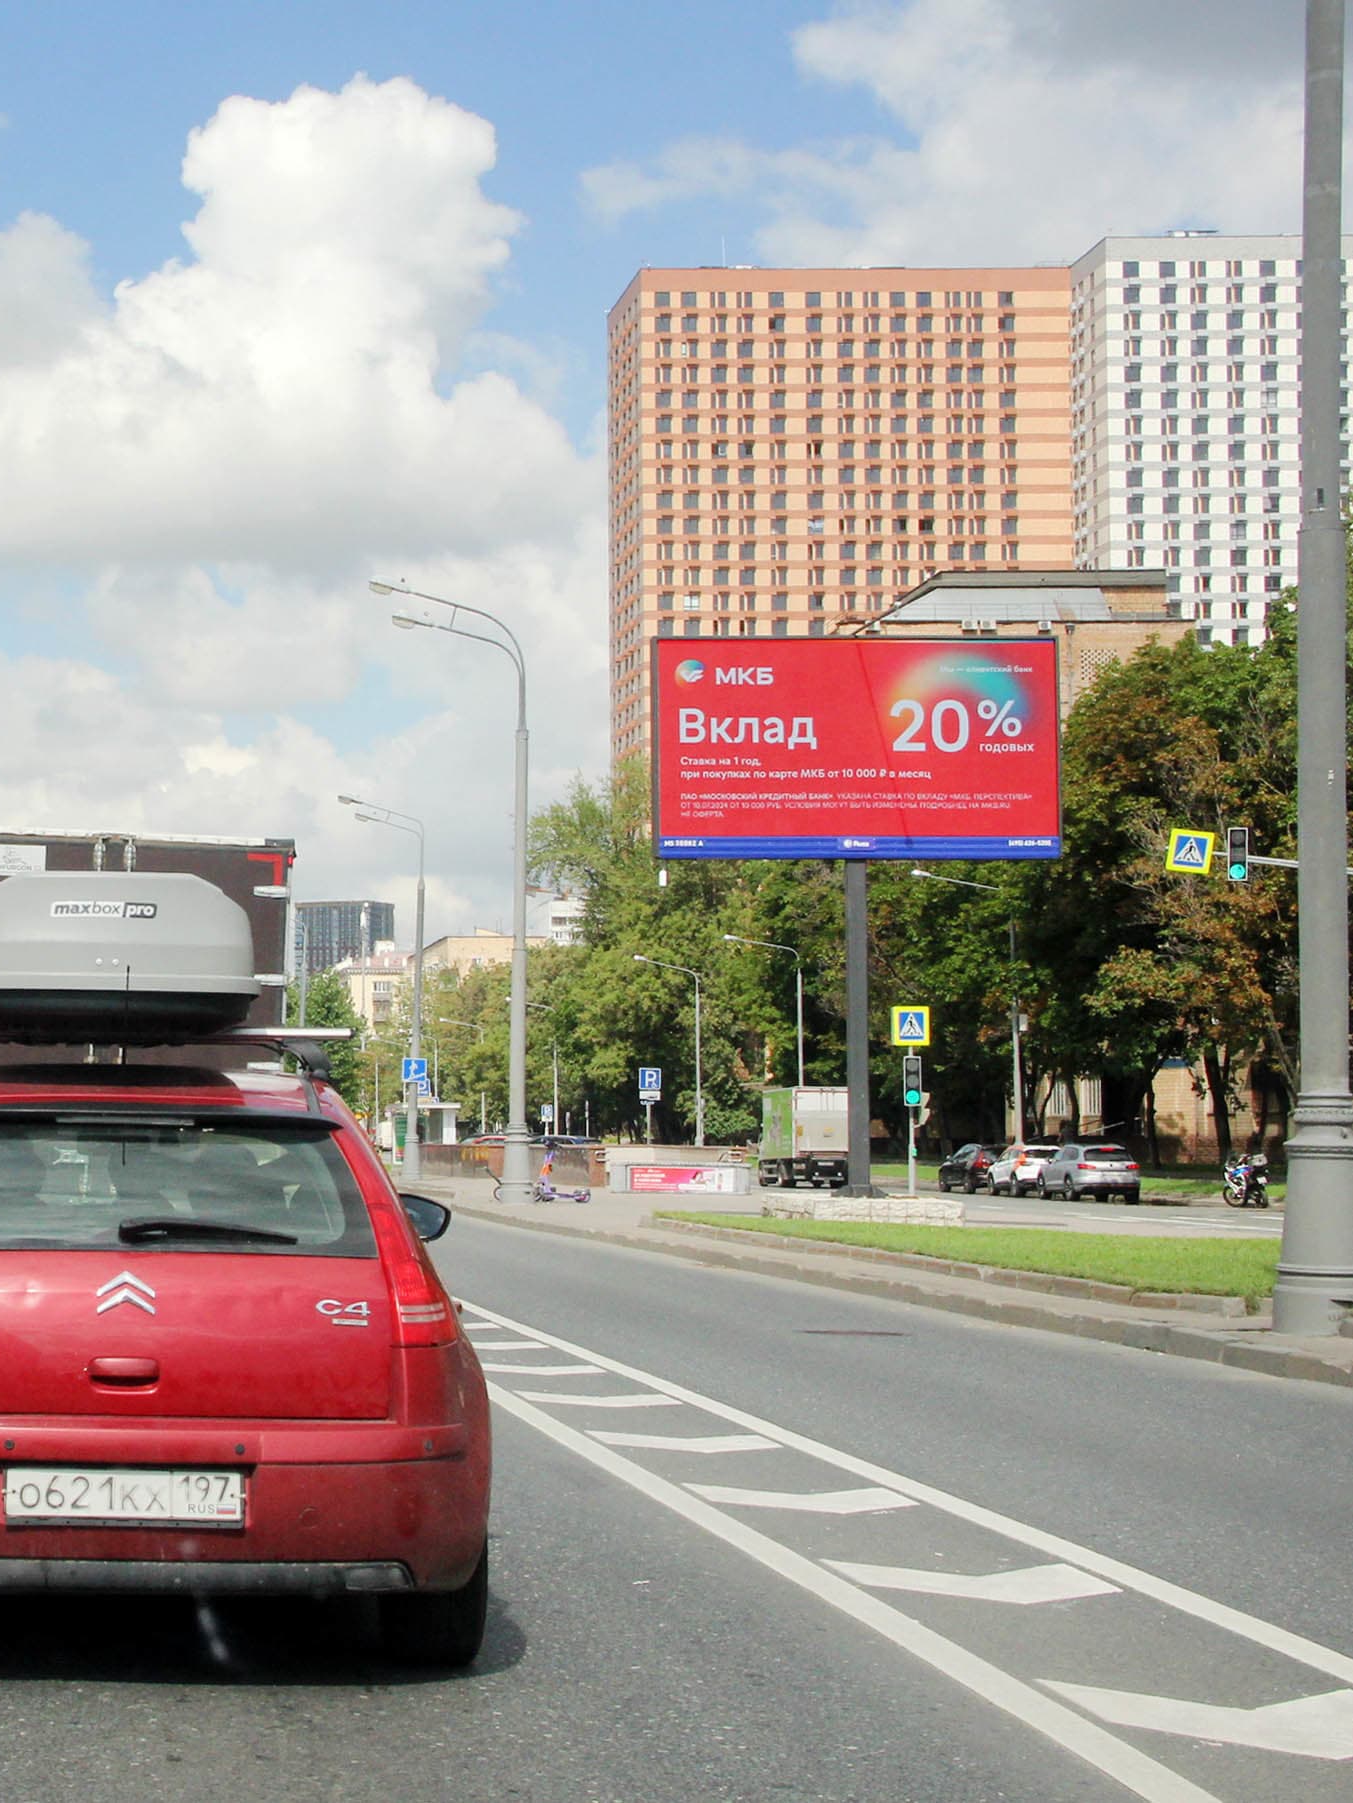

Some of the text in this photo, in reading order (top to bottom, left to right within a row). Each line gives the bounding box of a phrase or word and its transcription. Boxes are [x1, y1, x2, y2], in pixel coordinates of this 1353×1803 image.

[1014, 665, 1033, 673] банк
[715, 667, 774, 685] МКБ
[679, 708, 817, 750] Вклад
[890, 699, 1022, 752] 20%
[979, 743, 1034, 753] годовых
[680, 756, 716, 766] Ставка
[719, 758, 731, 766] на
[734, 756, 739, 766] 1
[681, 770, 700, 780] при
[703, 770, 750, 780] покупках
[753, 770, 766, 778] по
[769, 770, 798, 780] карте
[801, 769, 825, 778] МКБ
[827, 770, 839, 778] от
[842, 769, 853, 778] 10
[856, 769, 876, 778] 000
[899, 770, 931, 779] месяц
[759, 792, 807, 800] КРЕДИТНЫЙ
[54, 902, 156, 917] maxbox pro
[316, 1299, 371, 1316] C4
[179, 1476, 229, 1502] 197
[188, 1503, 215, 1514] RUS
